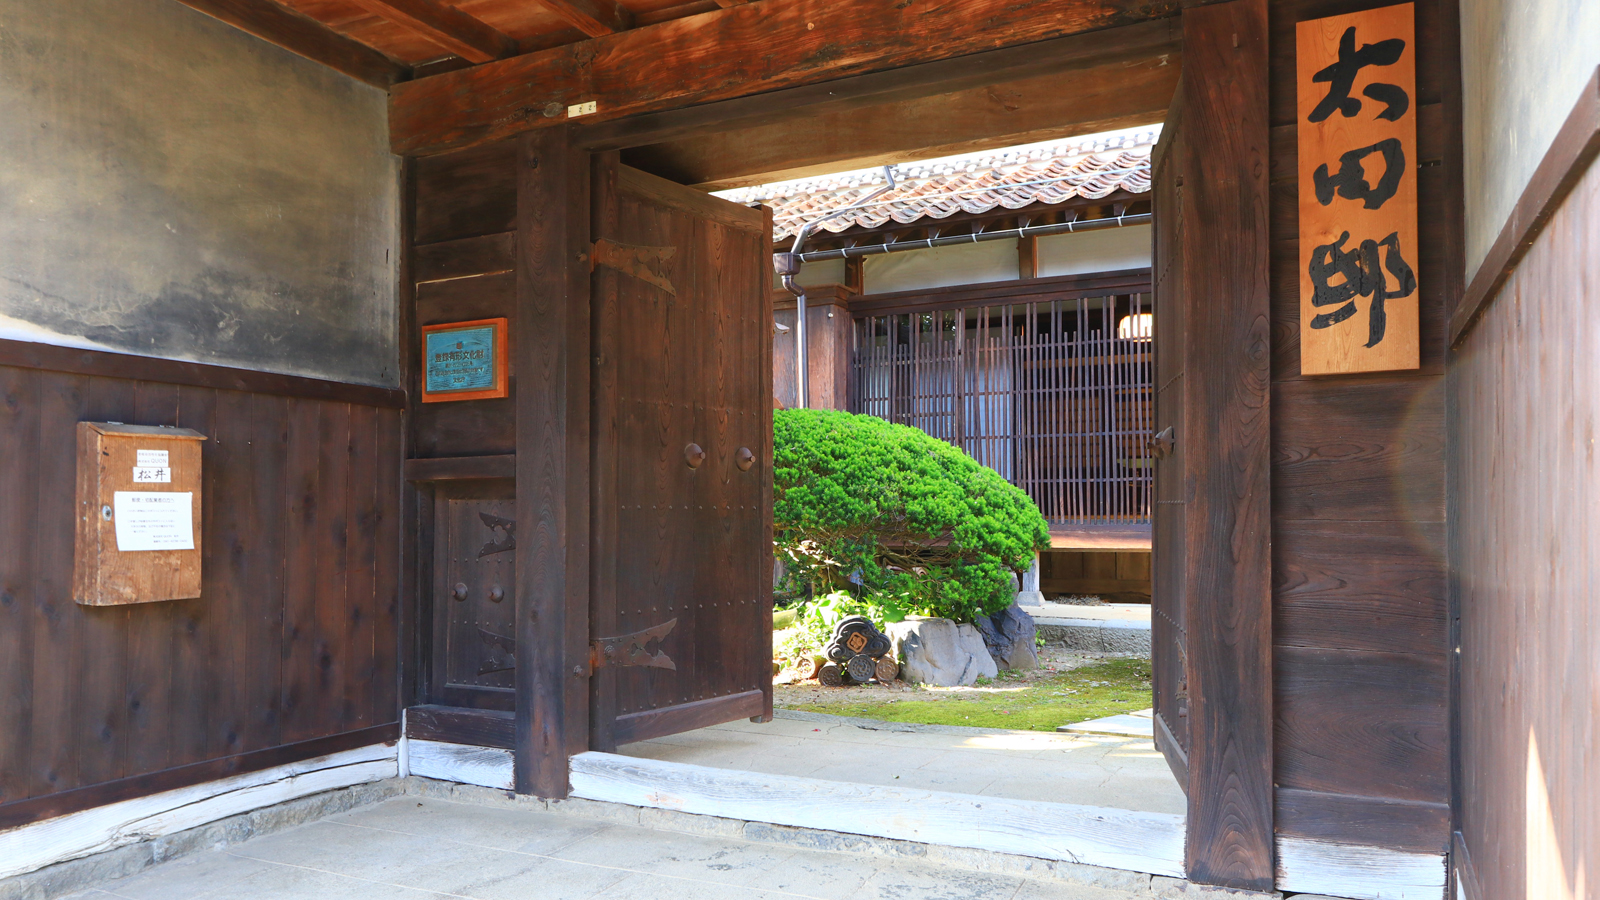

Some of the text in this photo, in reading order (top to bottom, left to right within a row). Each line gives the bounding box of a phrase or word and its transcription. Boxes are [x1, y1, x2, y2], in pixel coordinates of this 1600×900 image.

[1307, 26, 1417, 348] 太田邸
[138, 467, 166, 481] 松井
